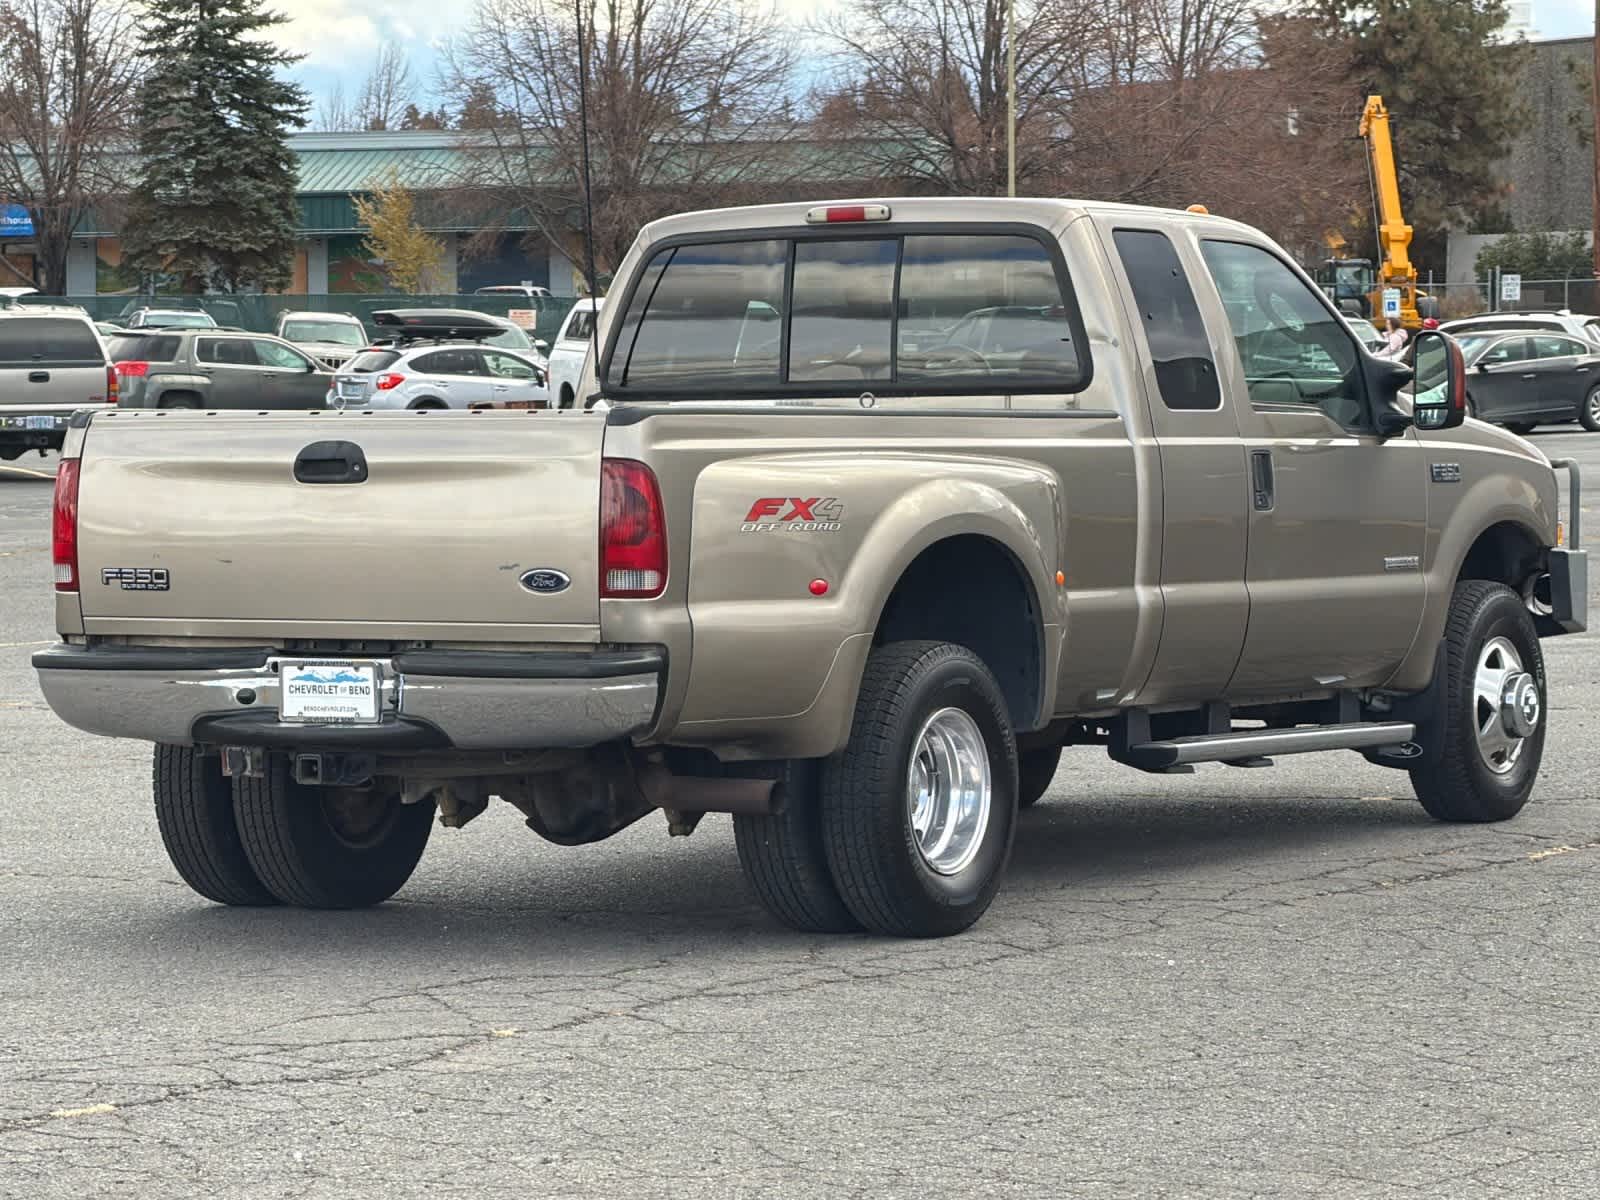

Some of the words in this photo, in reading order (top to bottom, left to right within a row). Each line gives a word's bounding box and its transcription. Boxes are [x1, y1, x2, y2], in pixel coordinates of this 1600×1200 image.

[744, 497, 843, 522] FX4
[741, 523, 781, 532] OFF
[788, 522, 841, 532] ROAD
[101, 568, 169, 585] F350
[288, 684, 339, 695] CHEVROLET
[349, 686, 371, 696] BEND
